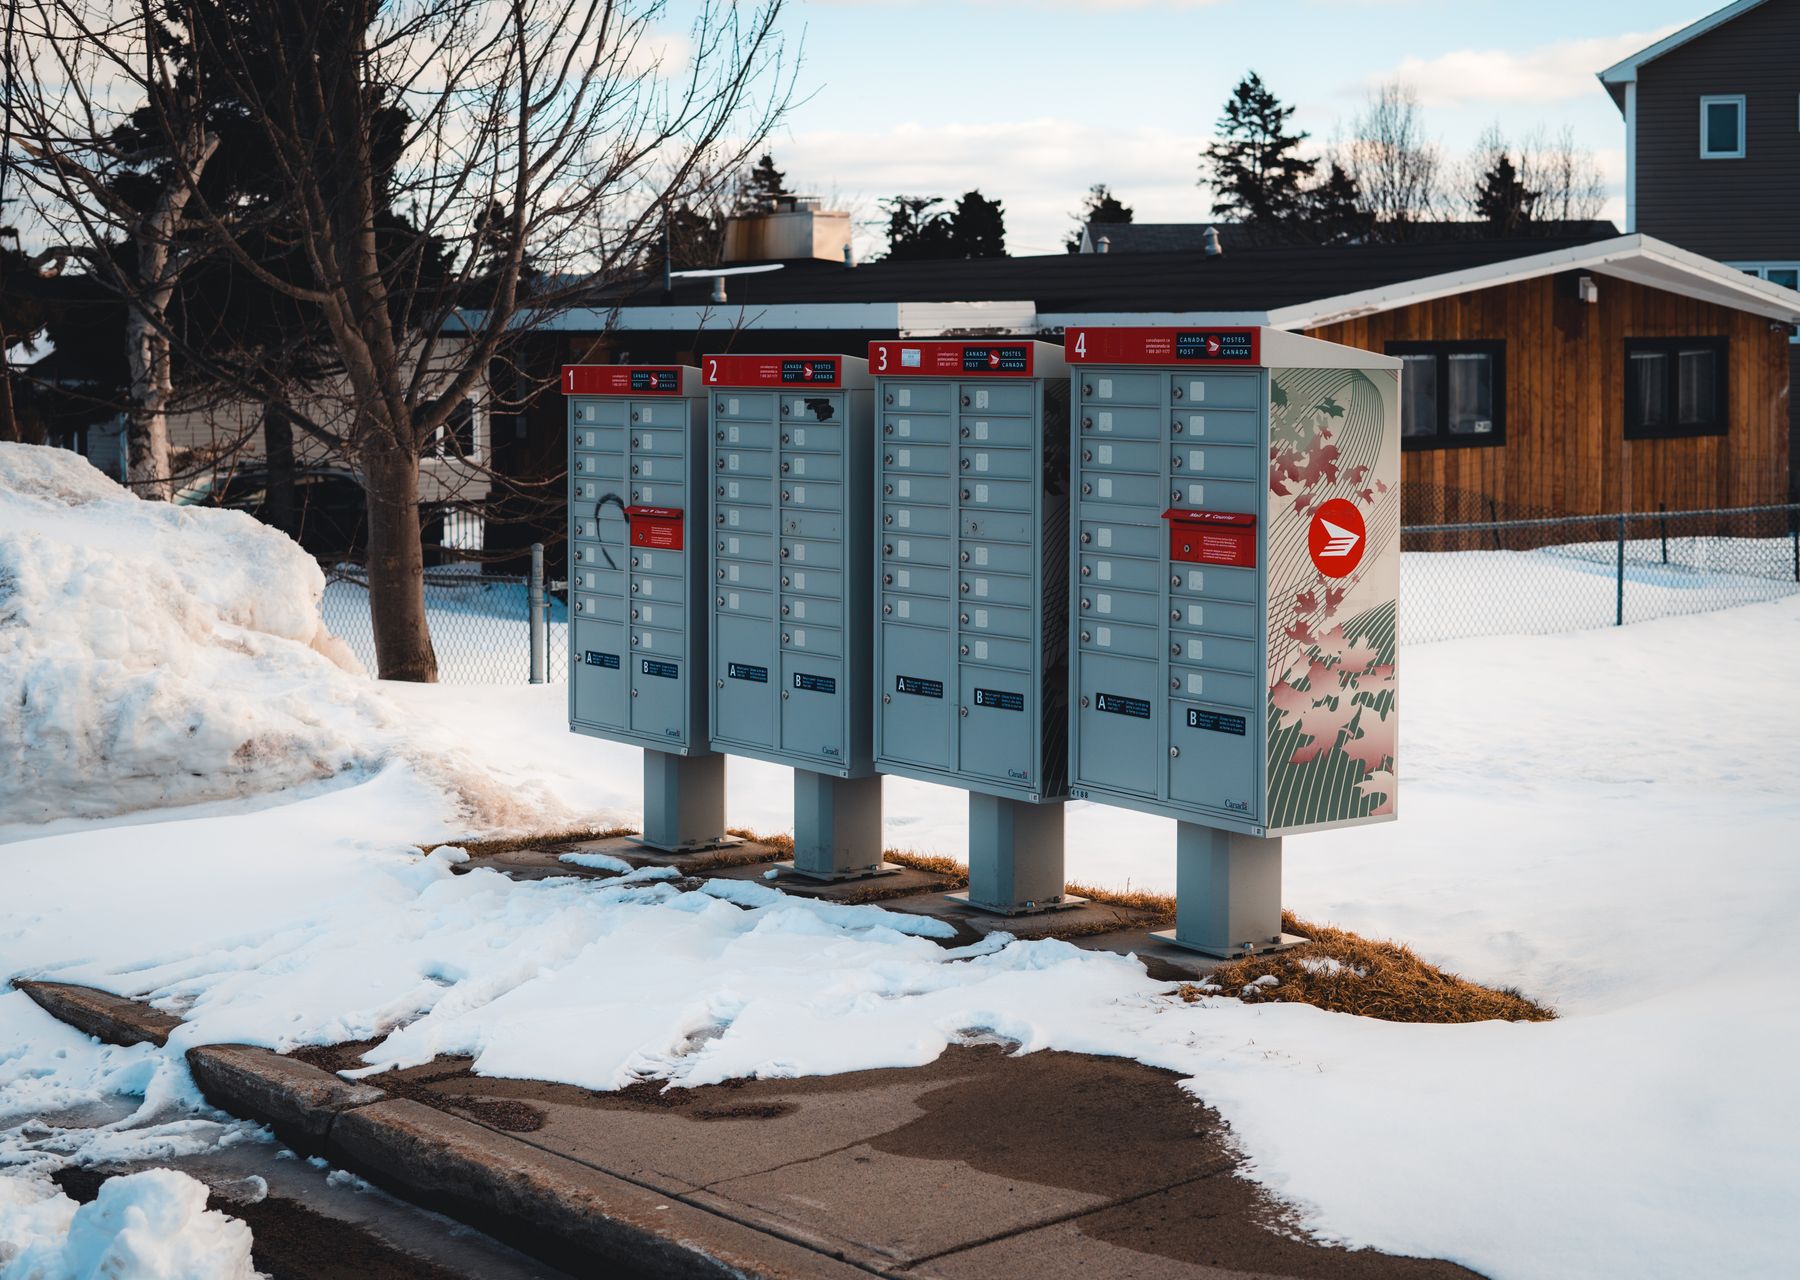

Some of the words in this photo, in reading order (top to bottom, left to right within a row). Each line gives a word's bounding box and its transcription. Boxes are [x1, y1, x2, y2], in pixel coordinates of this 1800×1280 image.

[1075, 332, 1086, 358] 4
[878, 346, 887, 370] 3
[709, 360, 717, 382] 2
[568, 370, 574, 390] 1
[587, 652, 592, 664] A
[644, 661, 648, 673] B
[730, 664, 736, 677] A
[796, 674, 801, 686] B
[898, 678, 905, 691] A
[977, 690, 983, 704] B
[1098, 696, 1106, 710] A
[1190, 711, 1197, 725] B
[1008, 769, 1028, 779] Canada
[1225, 799, 1248, 811] Canada
